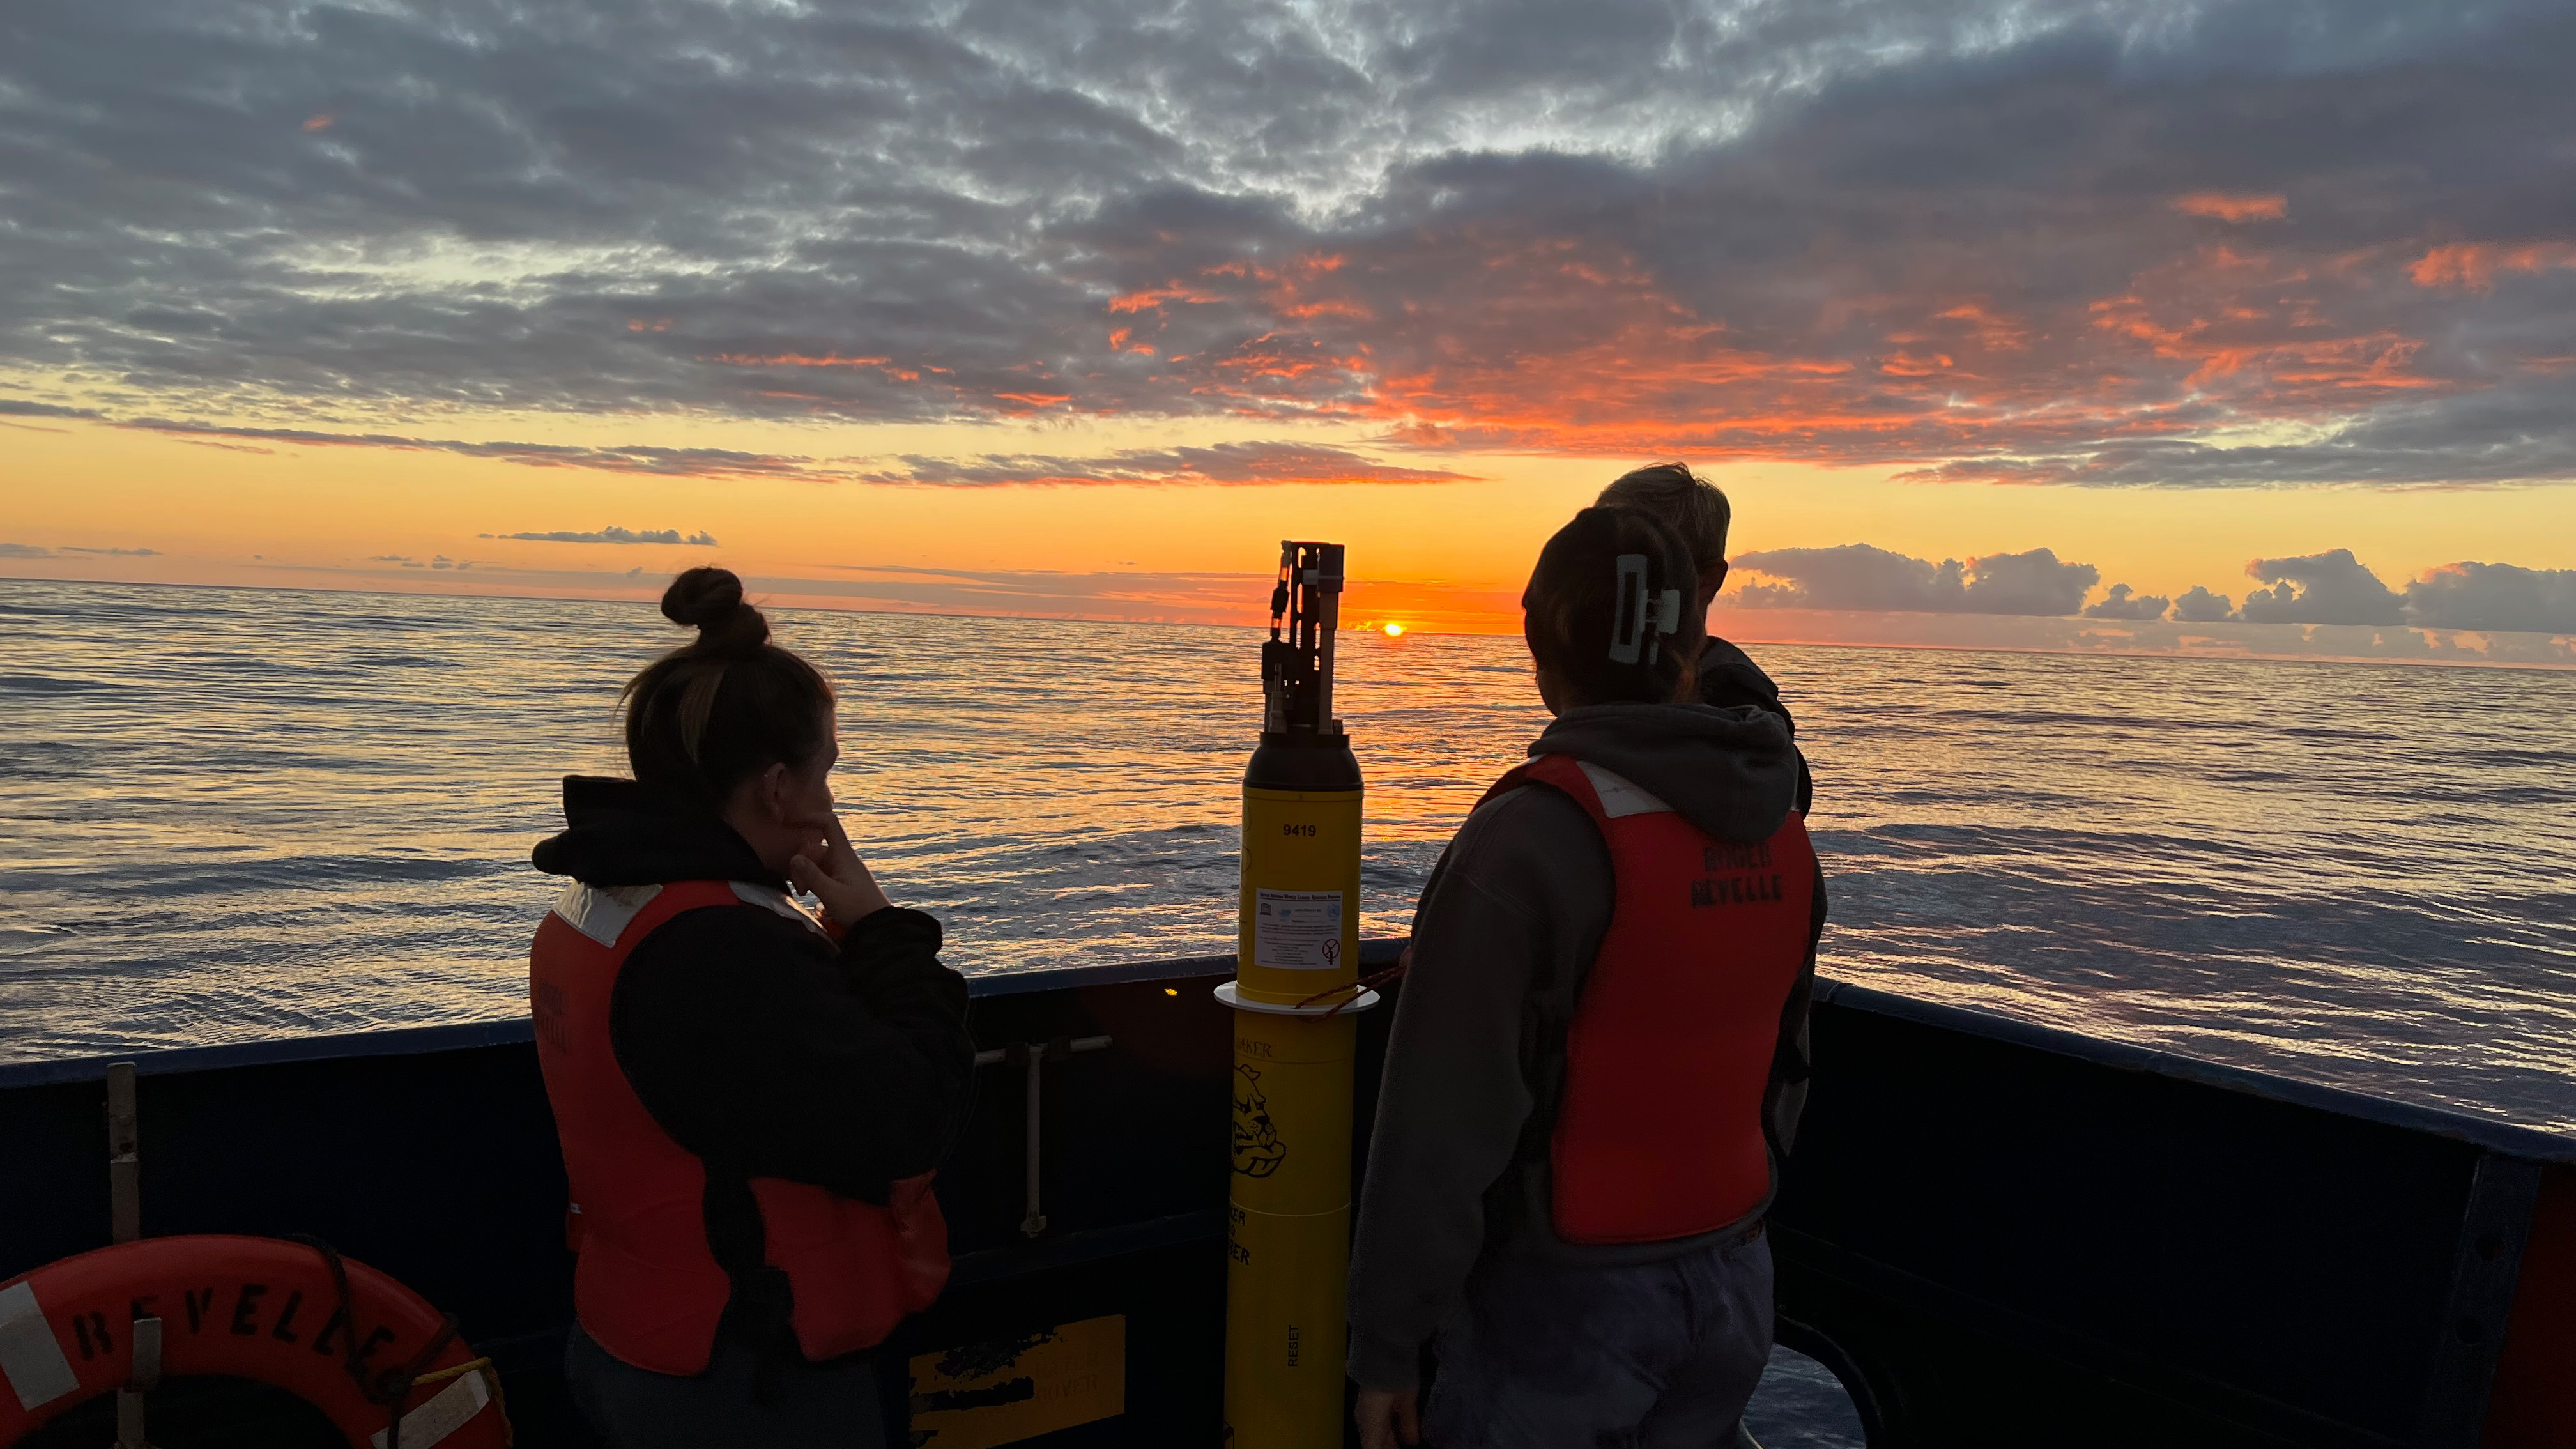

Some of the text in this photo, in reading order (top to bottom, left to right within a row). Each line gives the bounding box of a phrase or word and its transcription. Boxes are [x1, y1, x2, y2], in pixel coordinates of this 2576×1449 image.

[1283, 824, 1317, 837] 9419
[1691, 873, 1782, 906] REVELLE
[1287, 1324, 1299, 1367] RESET
